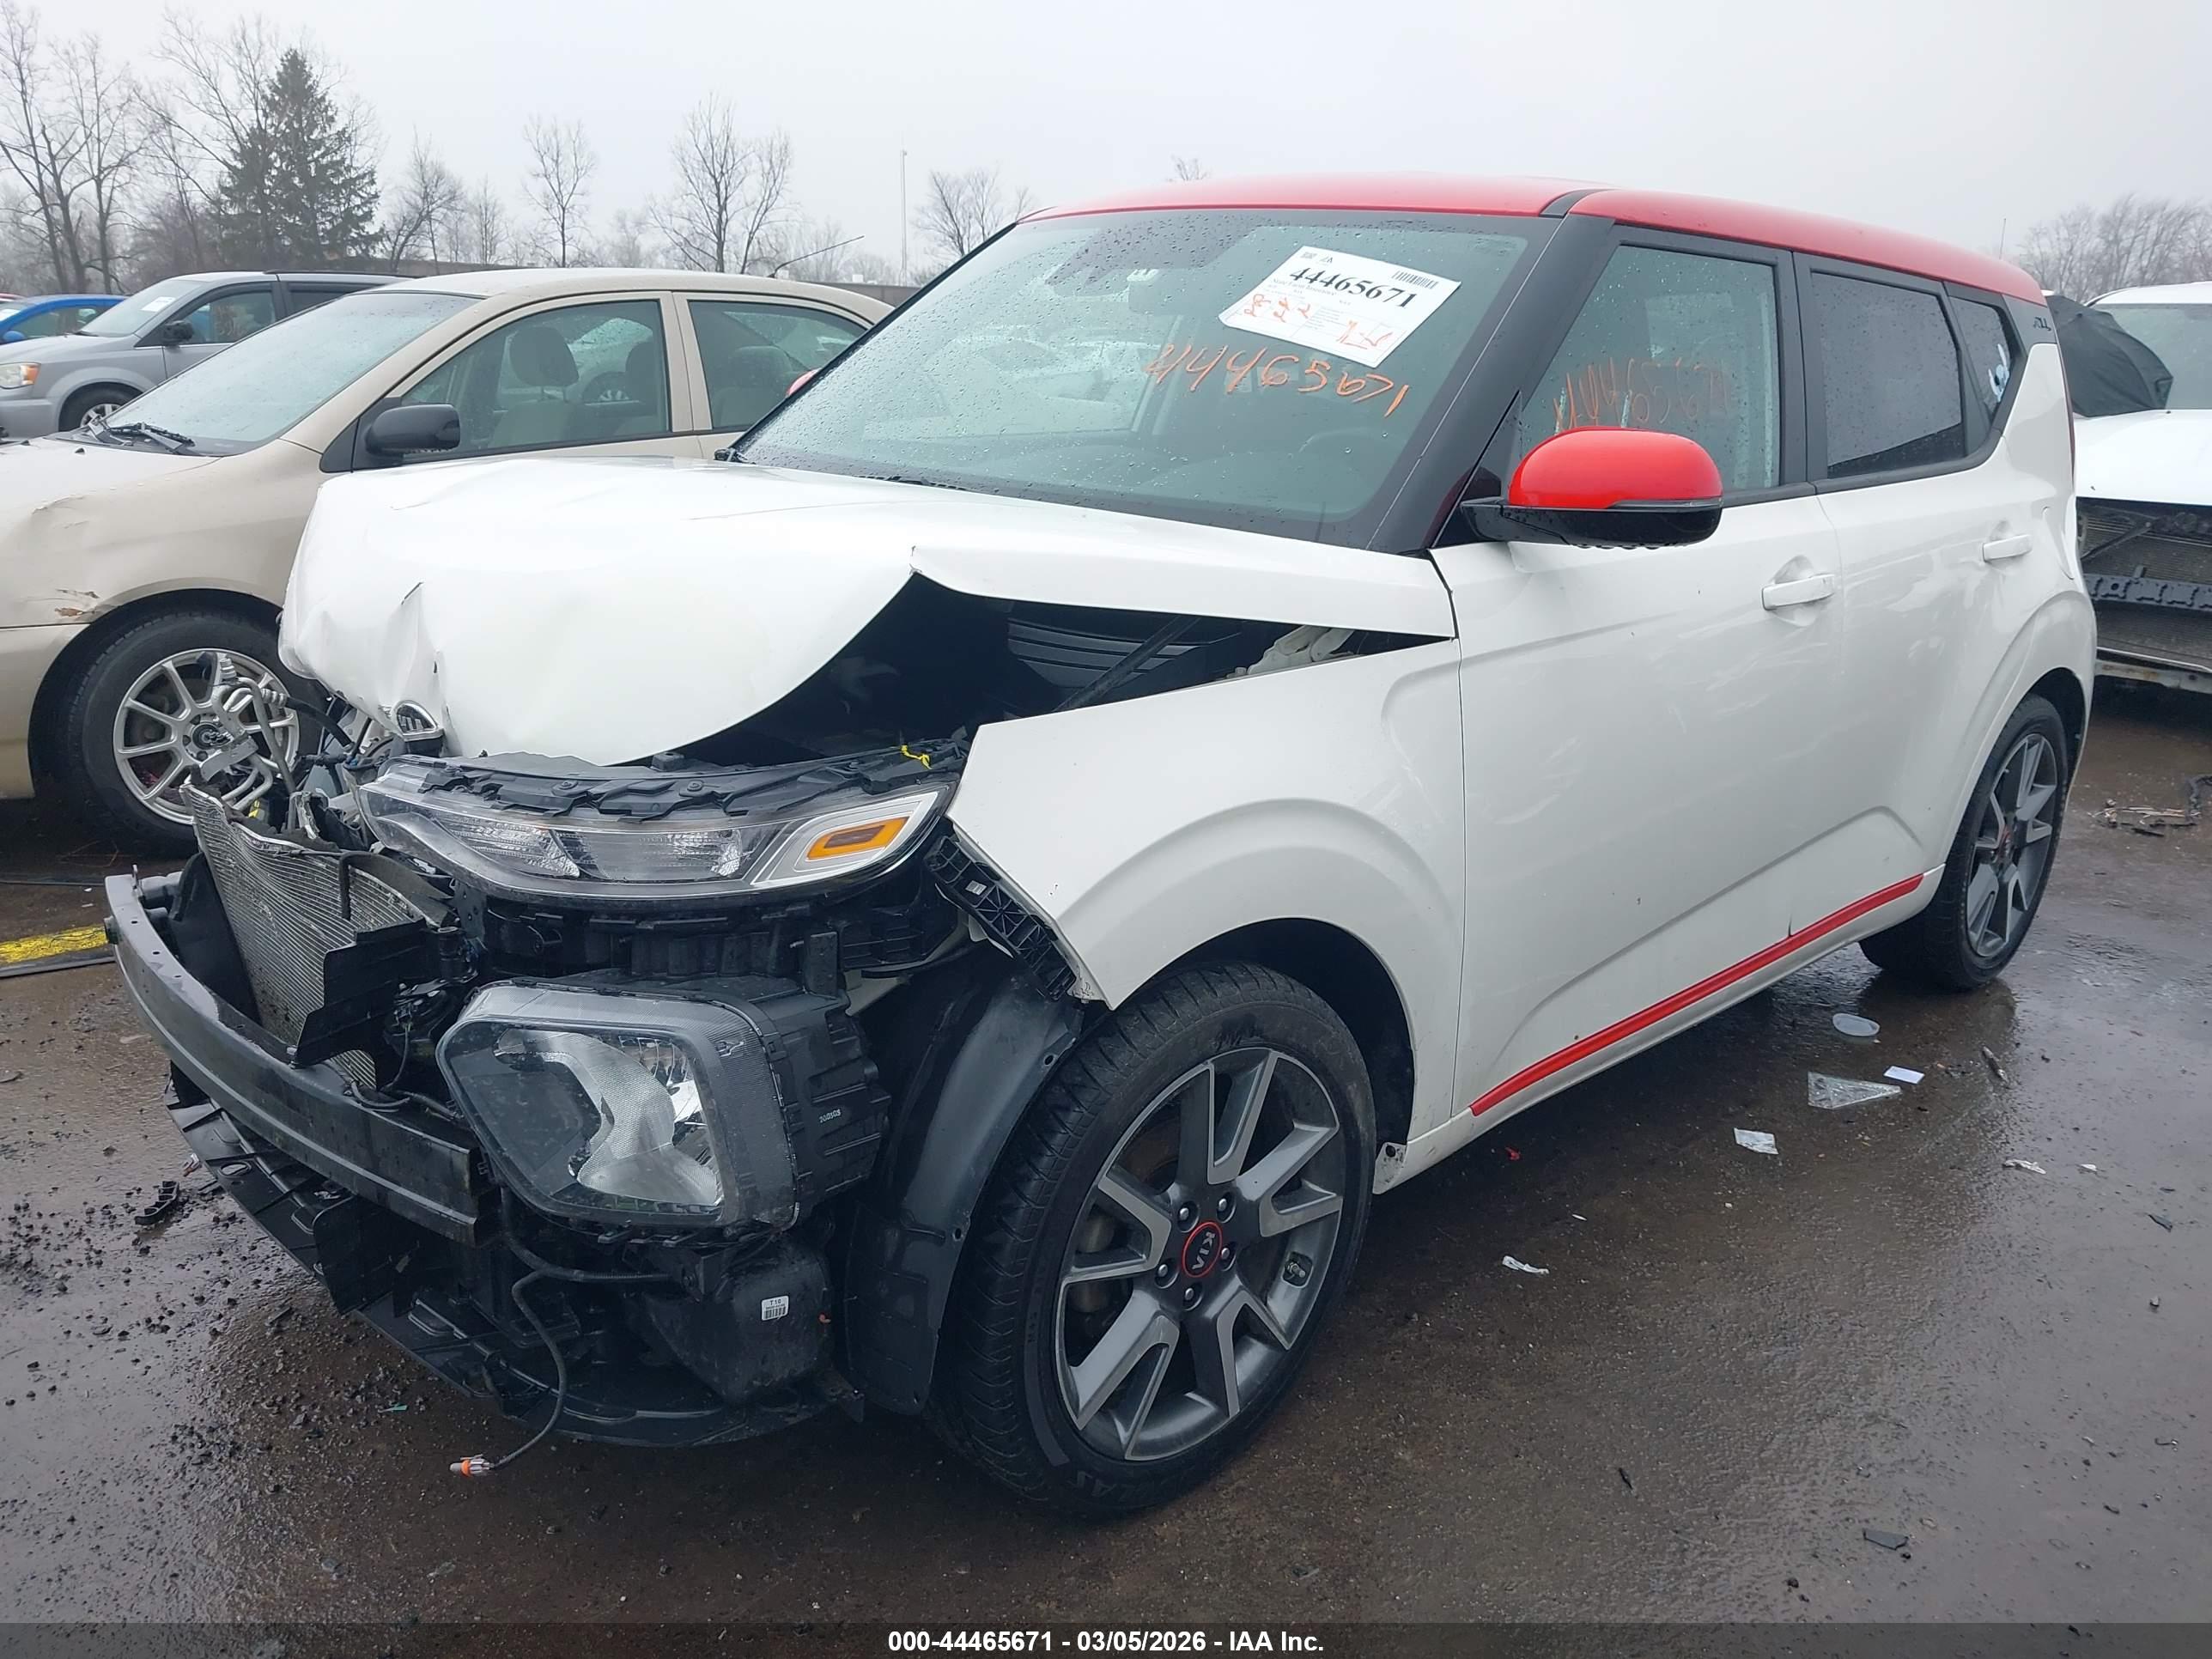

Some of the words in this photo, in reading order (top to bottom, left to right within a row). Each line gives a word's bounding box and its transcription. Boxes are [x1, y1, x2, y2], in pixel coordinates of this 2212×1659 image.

[1290, 267, 1418, 308] 44465671
[1145, 343, 1410, 418] 44465671
[1191, 1231, 1215, 1270] KIA
